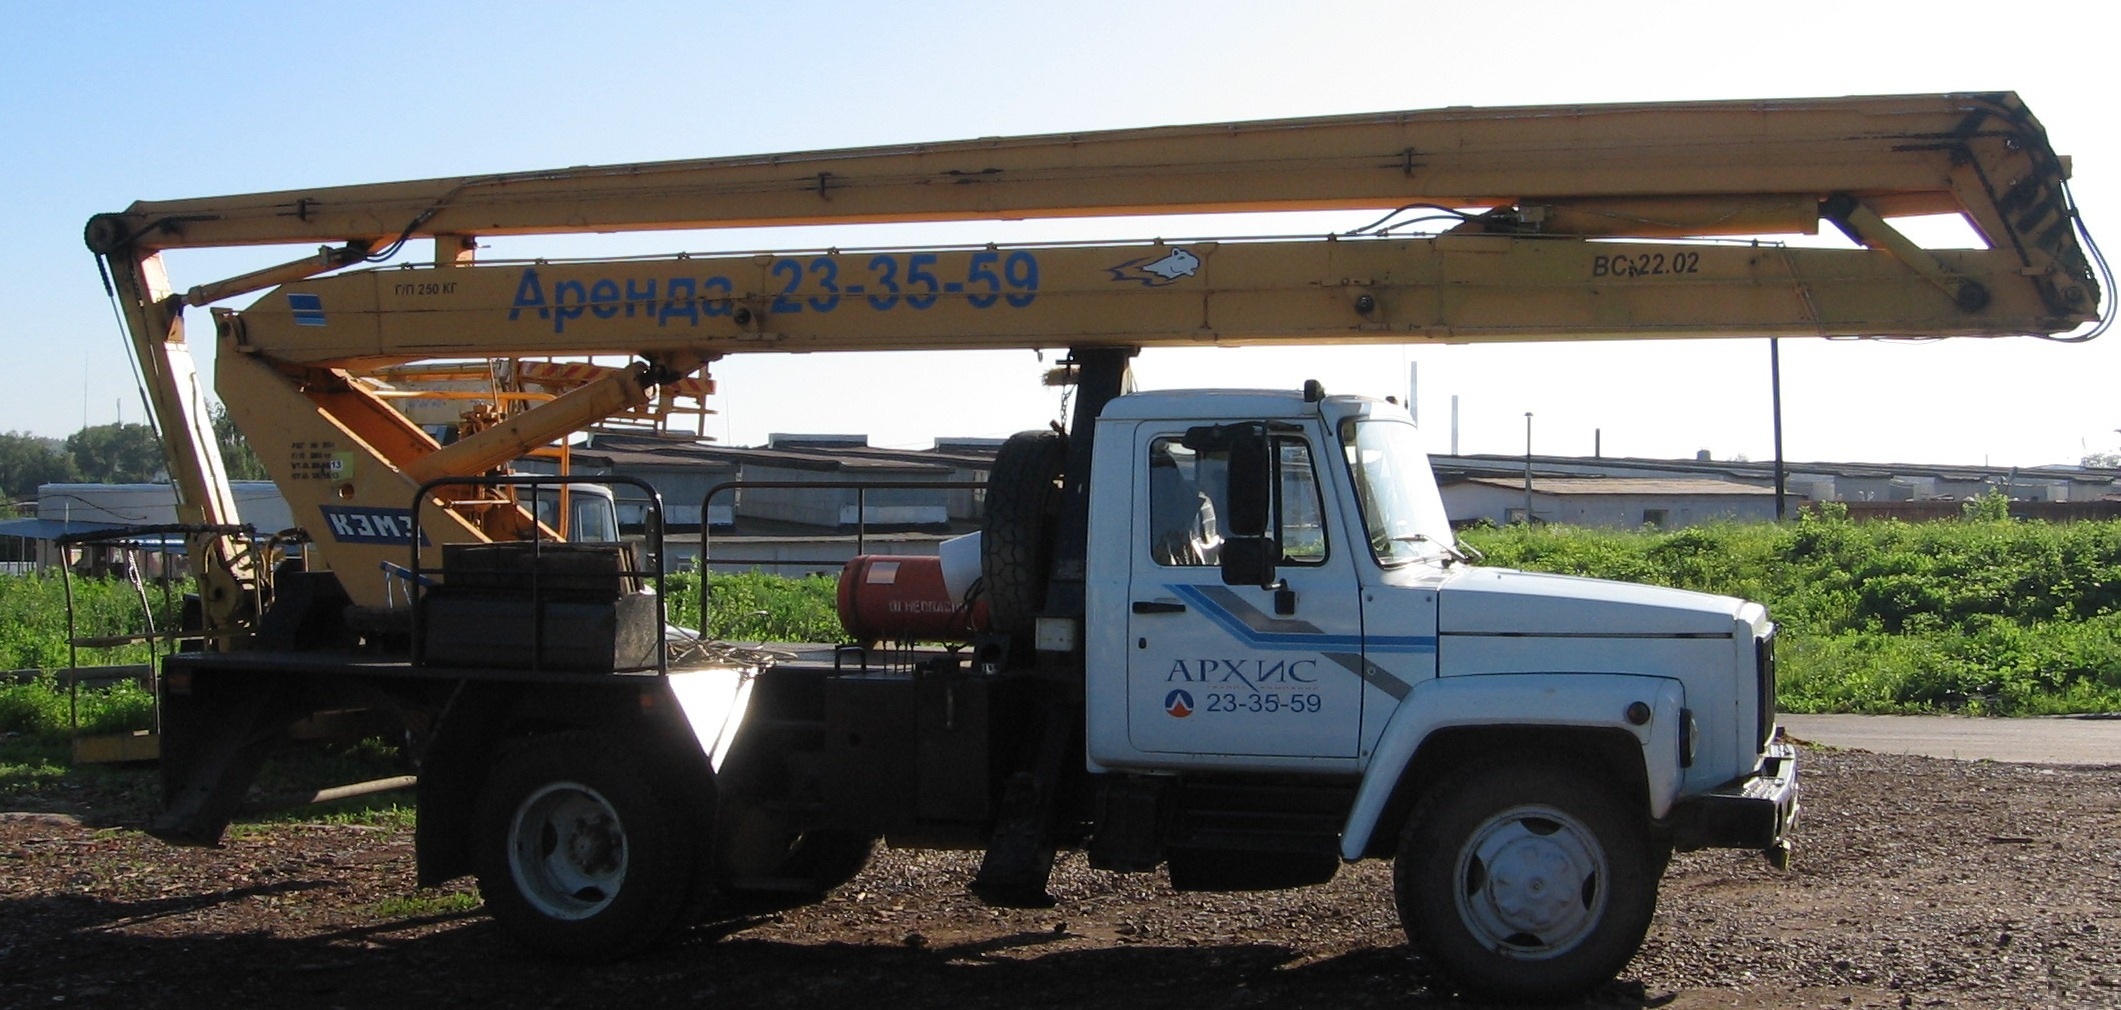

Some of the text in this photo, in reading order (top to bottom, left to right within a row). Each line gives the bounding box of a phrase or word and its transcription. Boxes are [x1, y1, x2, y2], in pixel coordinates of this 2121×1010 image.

[418, 283, 439, 295] 250
[443, 282, 458, 294] КГ
[508, 251, 1040, 333] Аренда 23-35-59
[1165, 658, 1319, 693] АРХИС
[1207, 693, 1322, 713] 23-35-59
